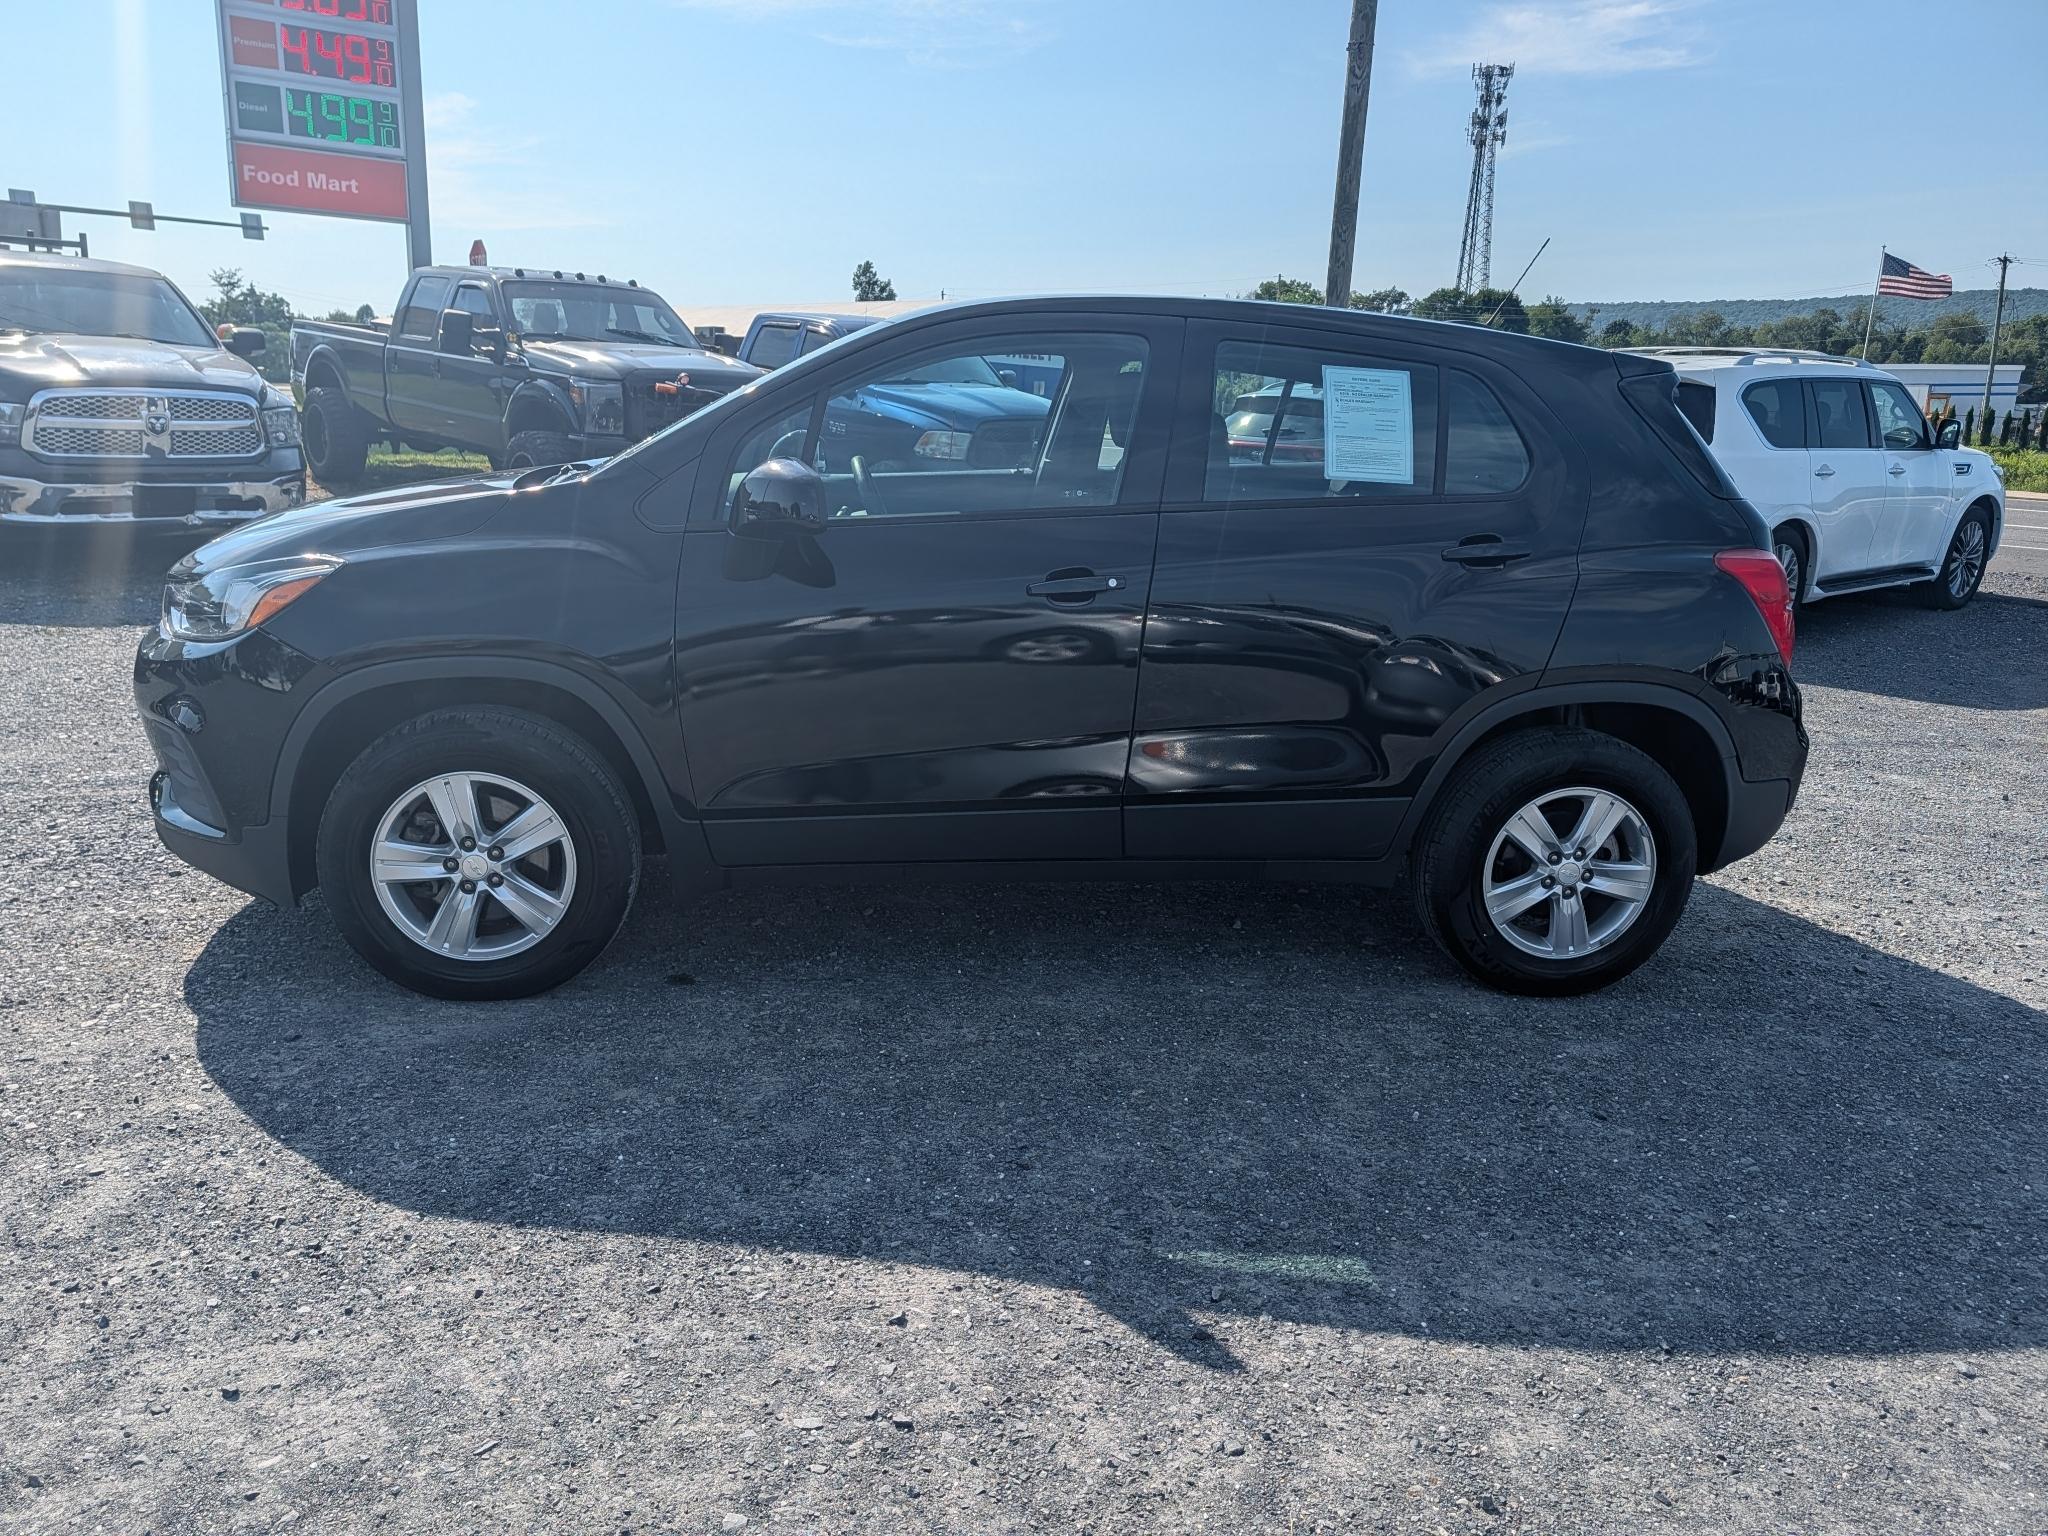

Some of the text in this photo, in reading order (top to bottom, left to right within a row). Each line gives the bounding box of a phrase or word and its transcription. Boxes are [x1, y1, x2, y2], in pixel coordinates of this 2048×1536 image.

[233, 26, 372, 84] Premium 4.49
[238, 89, 375, 145] Diesel 4.99
[242, 164, 360, 194] Food Mart
